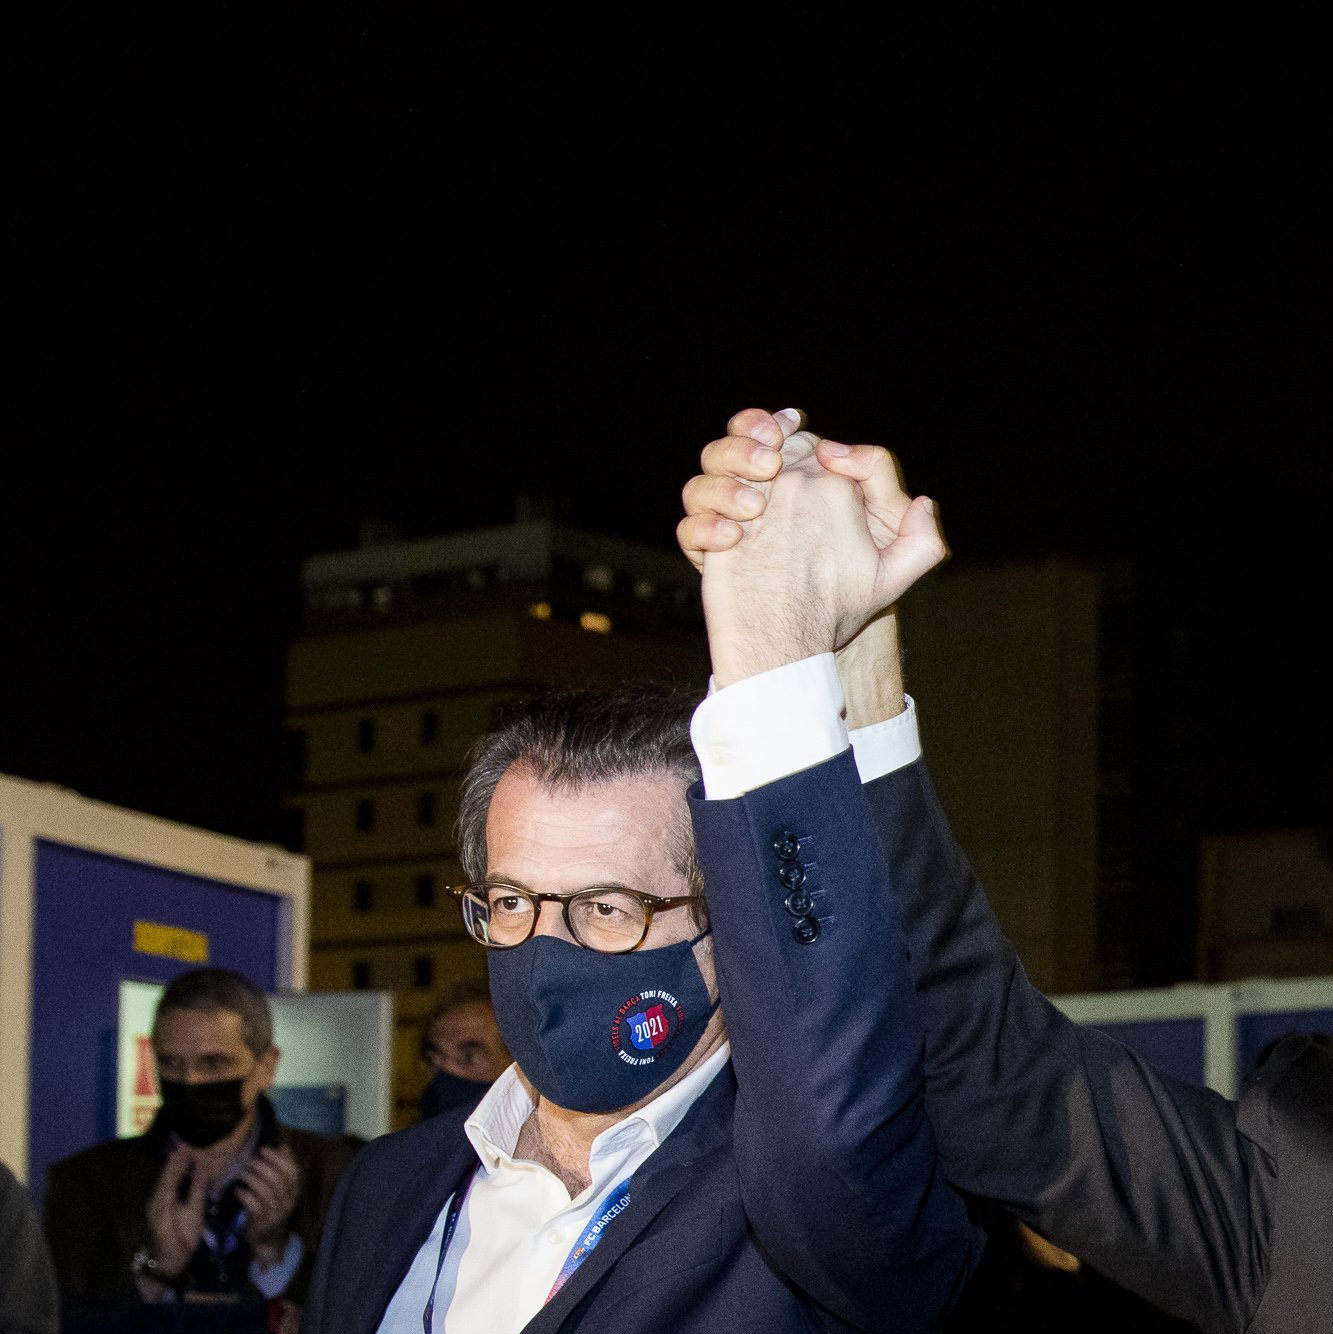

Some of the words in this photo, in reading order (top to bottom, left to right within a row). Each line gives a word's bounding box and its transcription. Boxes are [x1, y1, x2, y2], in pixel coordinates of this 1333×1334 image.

[618, 995, 641, 1014] BARÇA
[640, 990, 656, 1000] TONI
[657, 990, 678, 1007] FREIXA
[635, 1015, 663, 1043] 2021
[618, 1050, 638, 1066] FREIXA
[639, 1056, 655, 1066] TONI
[584, 1232, 597, 1247] FC
